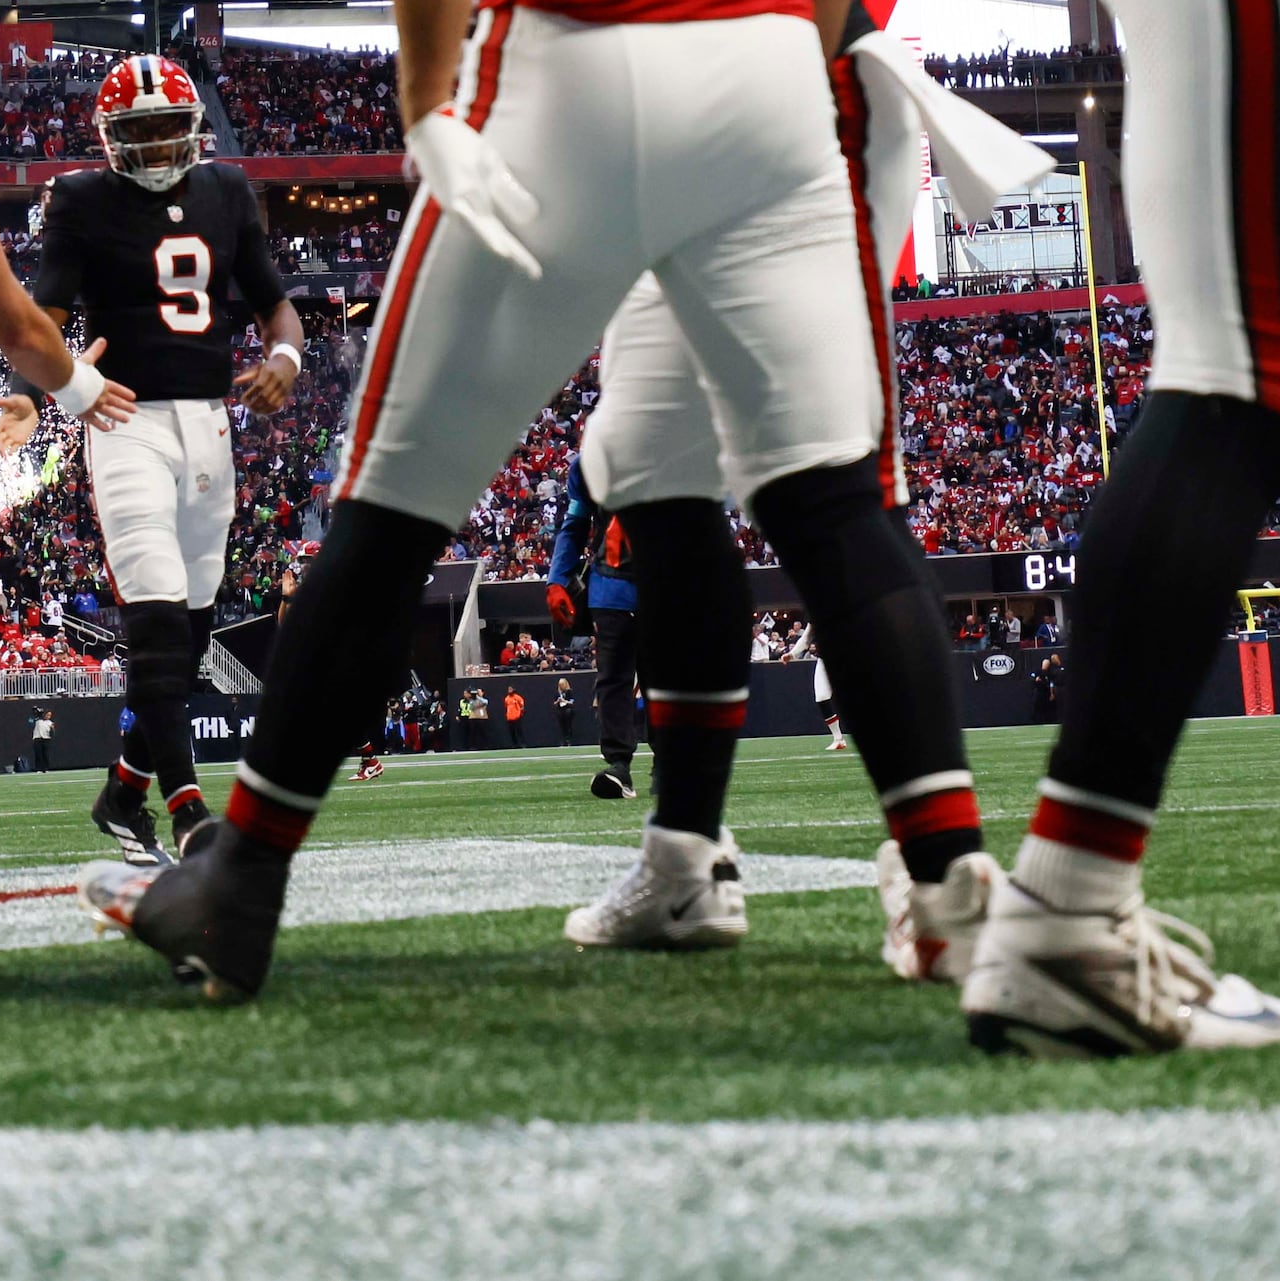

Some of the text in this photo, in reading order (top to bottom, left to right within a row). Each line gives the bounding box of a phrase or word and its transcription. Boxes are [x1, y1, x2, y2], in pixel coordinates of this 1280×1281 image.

[200, 36, 218, 47] 246
[153, 234, 214, 334] 9
[989, 658, 1008, 668] FOX
